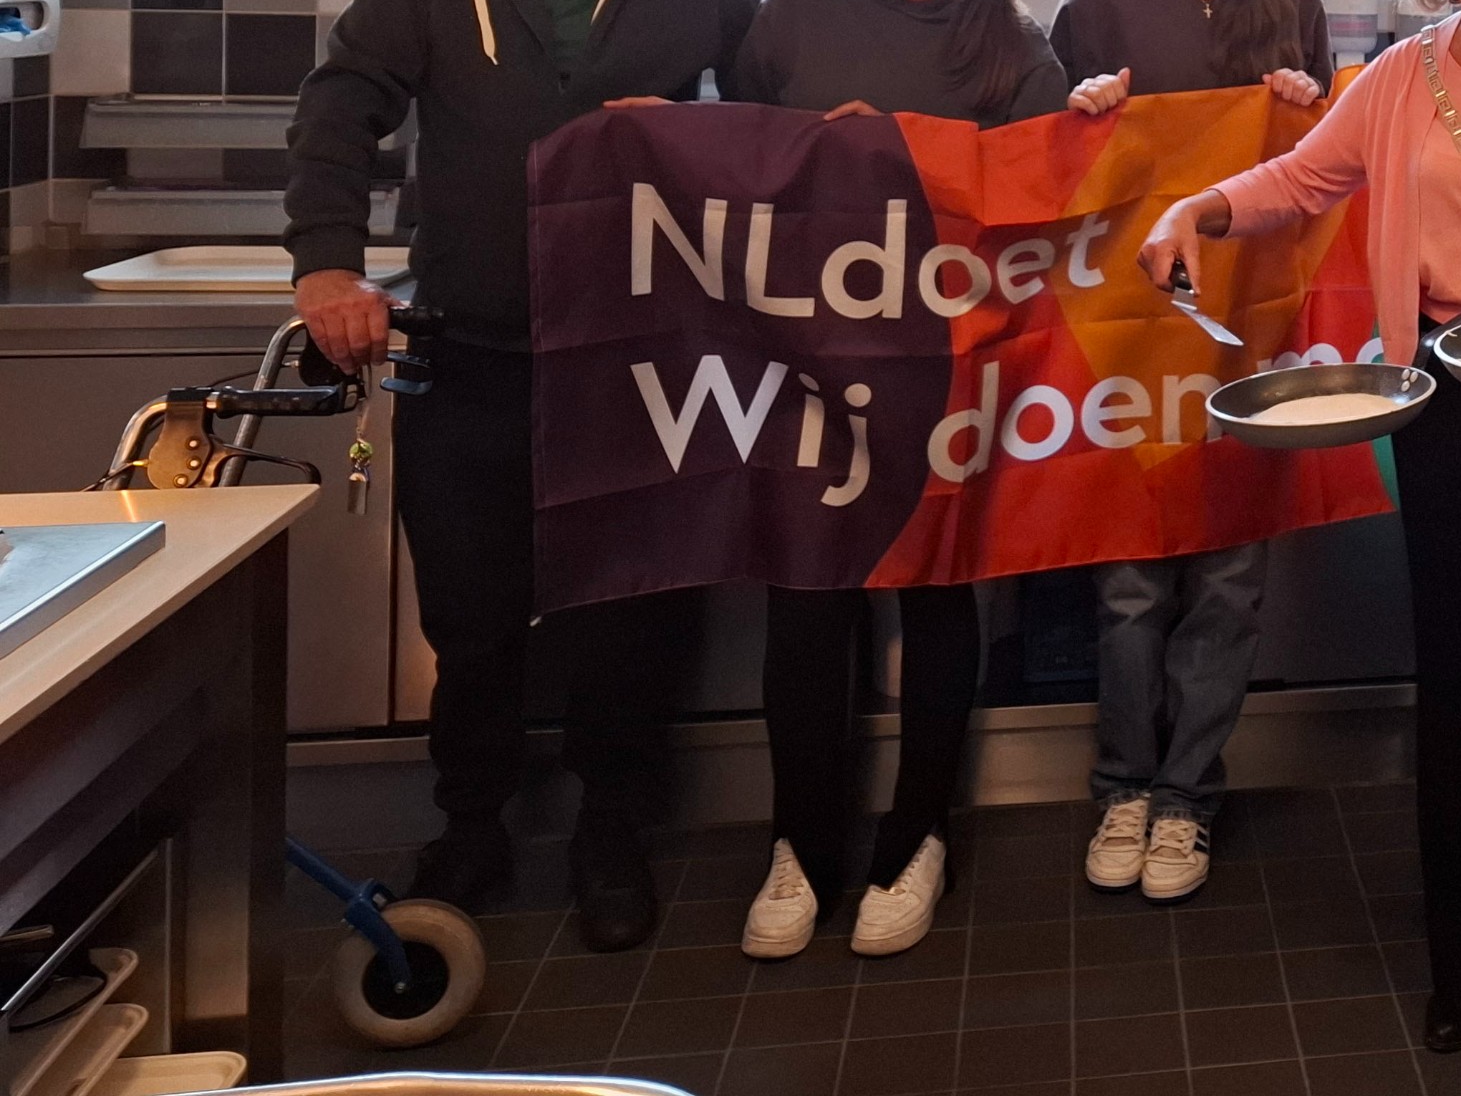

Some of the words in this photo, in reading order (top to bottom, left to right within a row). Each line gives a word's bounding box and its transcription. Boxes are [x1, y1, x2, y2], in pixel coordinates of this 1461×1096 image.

[631, 182, 1109, 319] NLdoet
[630, 354, 872, 508] Wij
[927, 360, 1224, 483] doen
